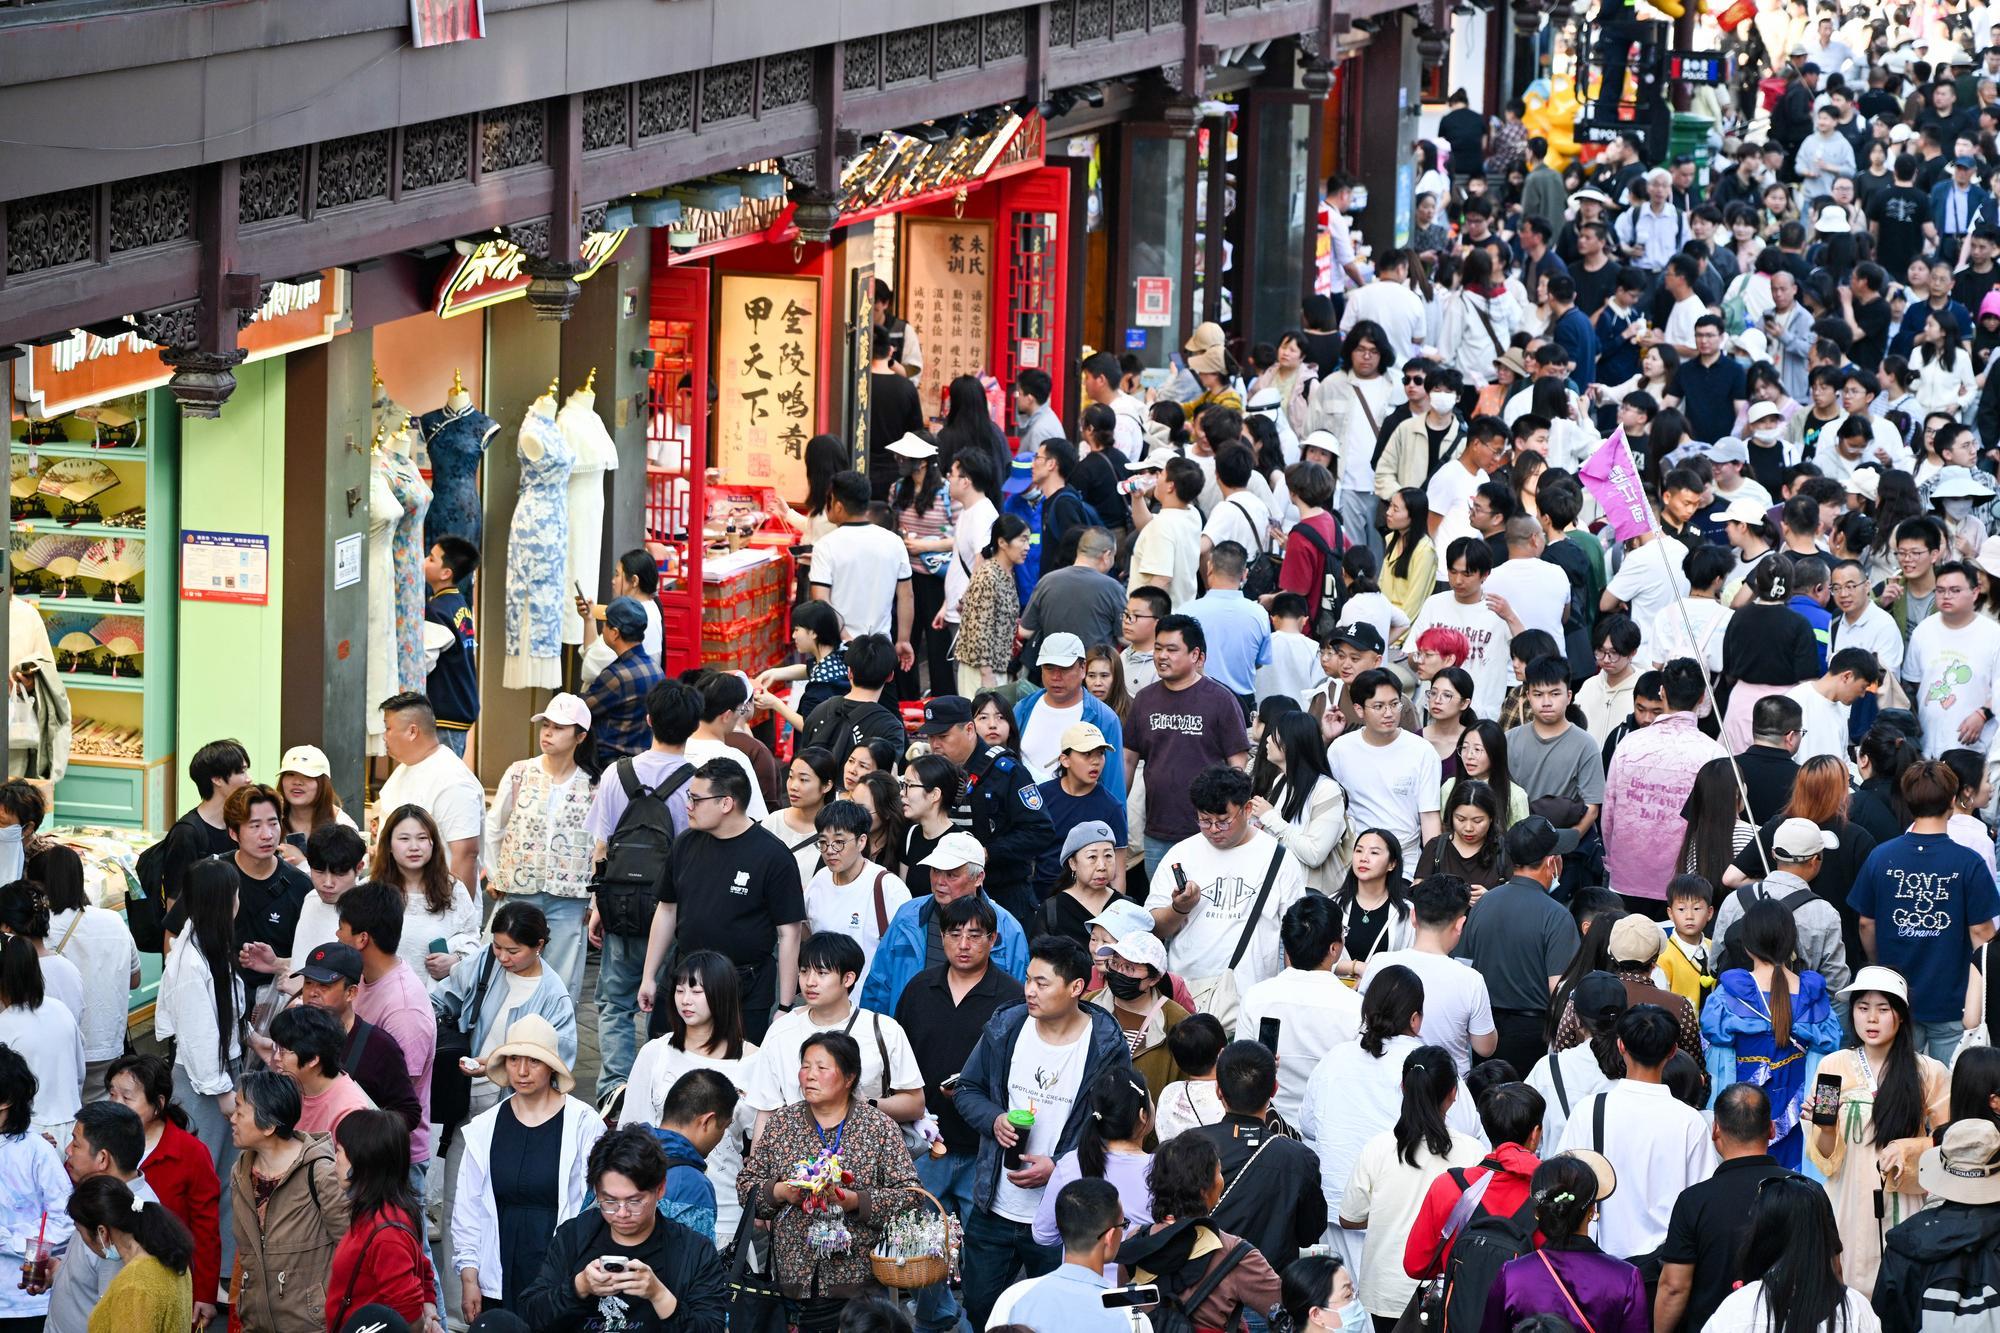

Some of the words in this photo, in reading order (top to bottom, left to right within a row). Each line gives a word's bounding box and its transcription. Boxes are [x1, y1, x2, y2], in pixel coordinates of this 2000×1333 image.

[1682, 71, 1708, 80] POLICE
[947, 234, 965, 274] 家训
[969, 234, 985, 275] 朱氏
[741, 296, 773, 426] 甲天下
[1892, 908, 1951, 930] GOOD
[1898, 923, 1940, 937] Brand
[1046, 1093, 1073, 1104] CREATOR
